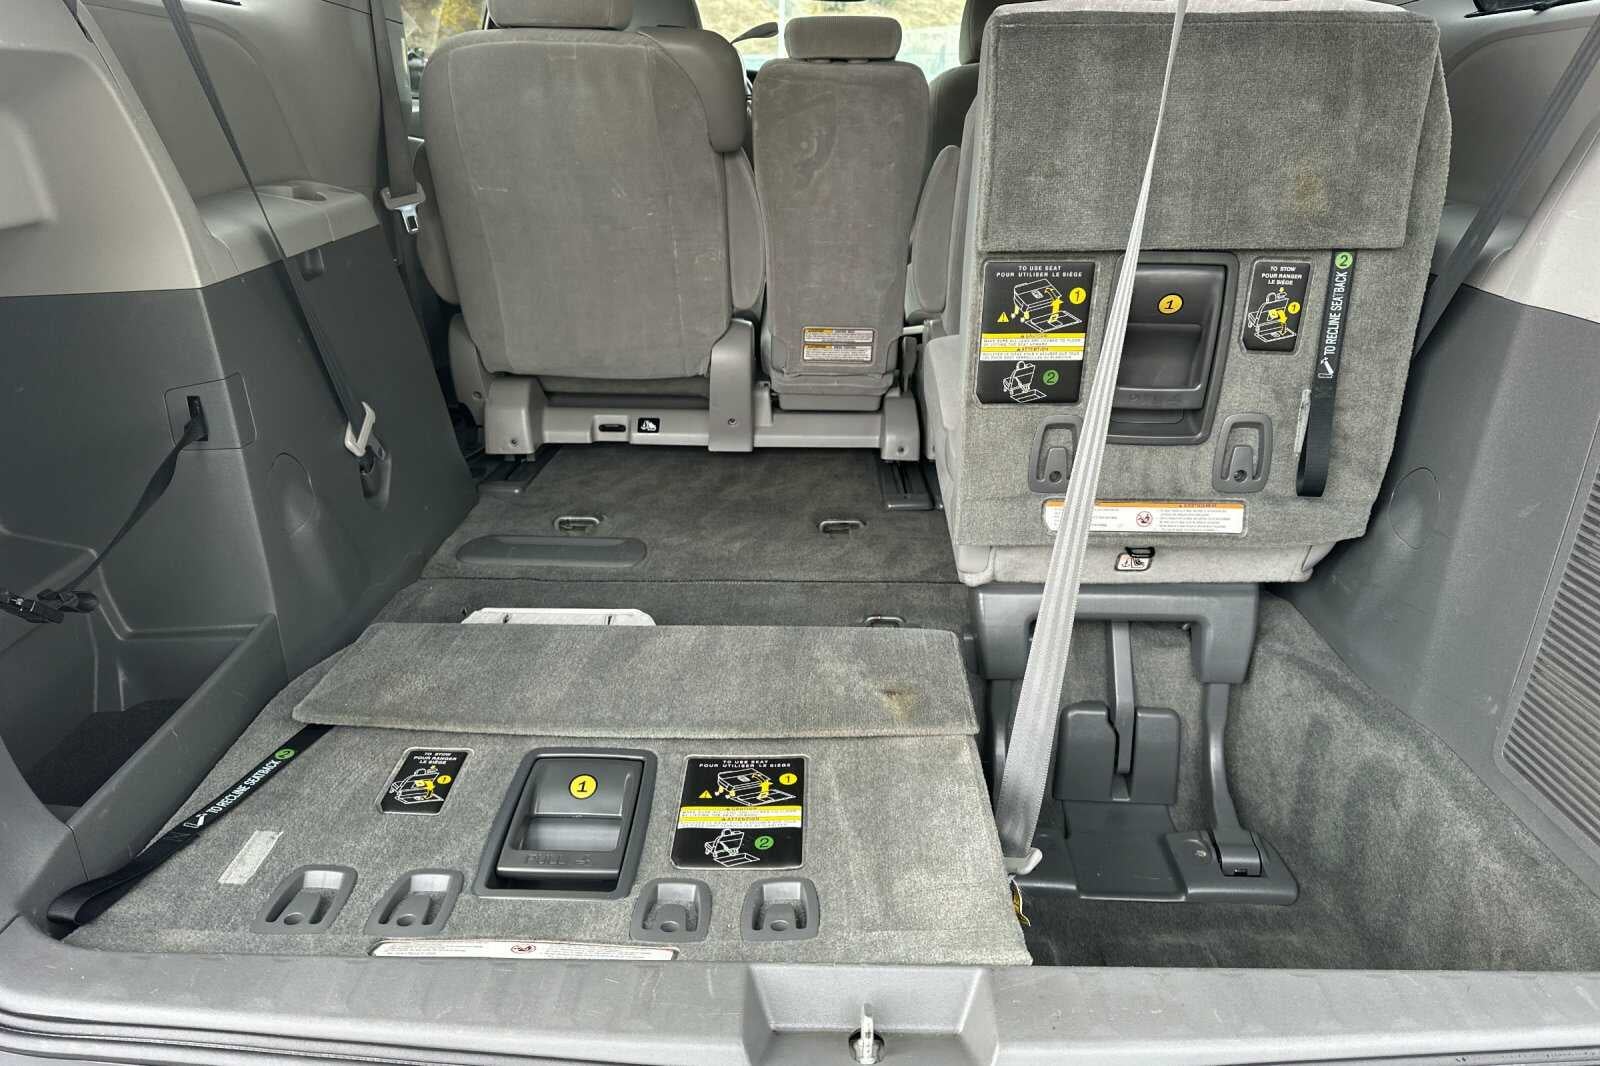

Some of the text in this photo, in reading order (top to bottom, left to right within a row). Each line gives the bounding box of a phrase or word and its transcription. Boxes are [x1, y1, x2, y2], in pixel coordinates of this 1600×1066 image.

[1324, 271, 1348, 355] TO RECLINE SEATBACK
[206, 759, 281, 814] TO RECLINE SEATBACK
